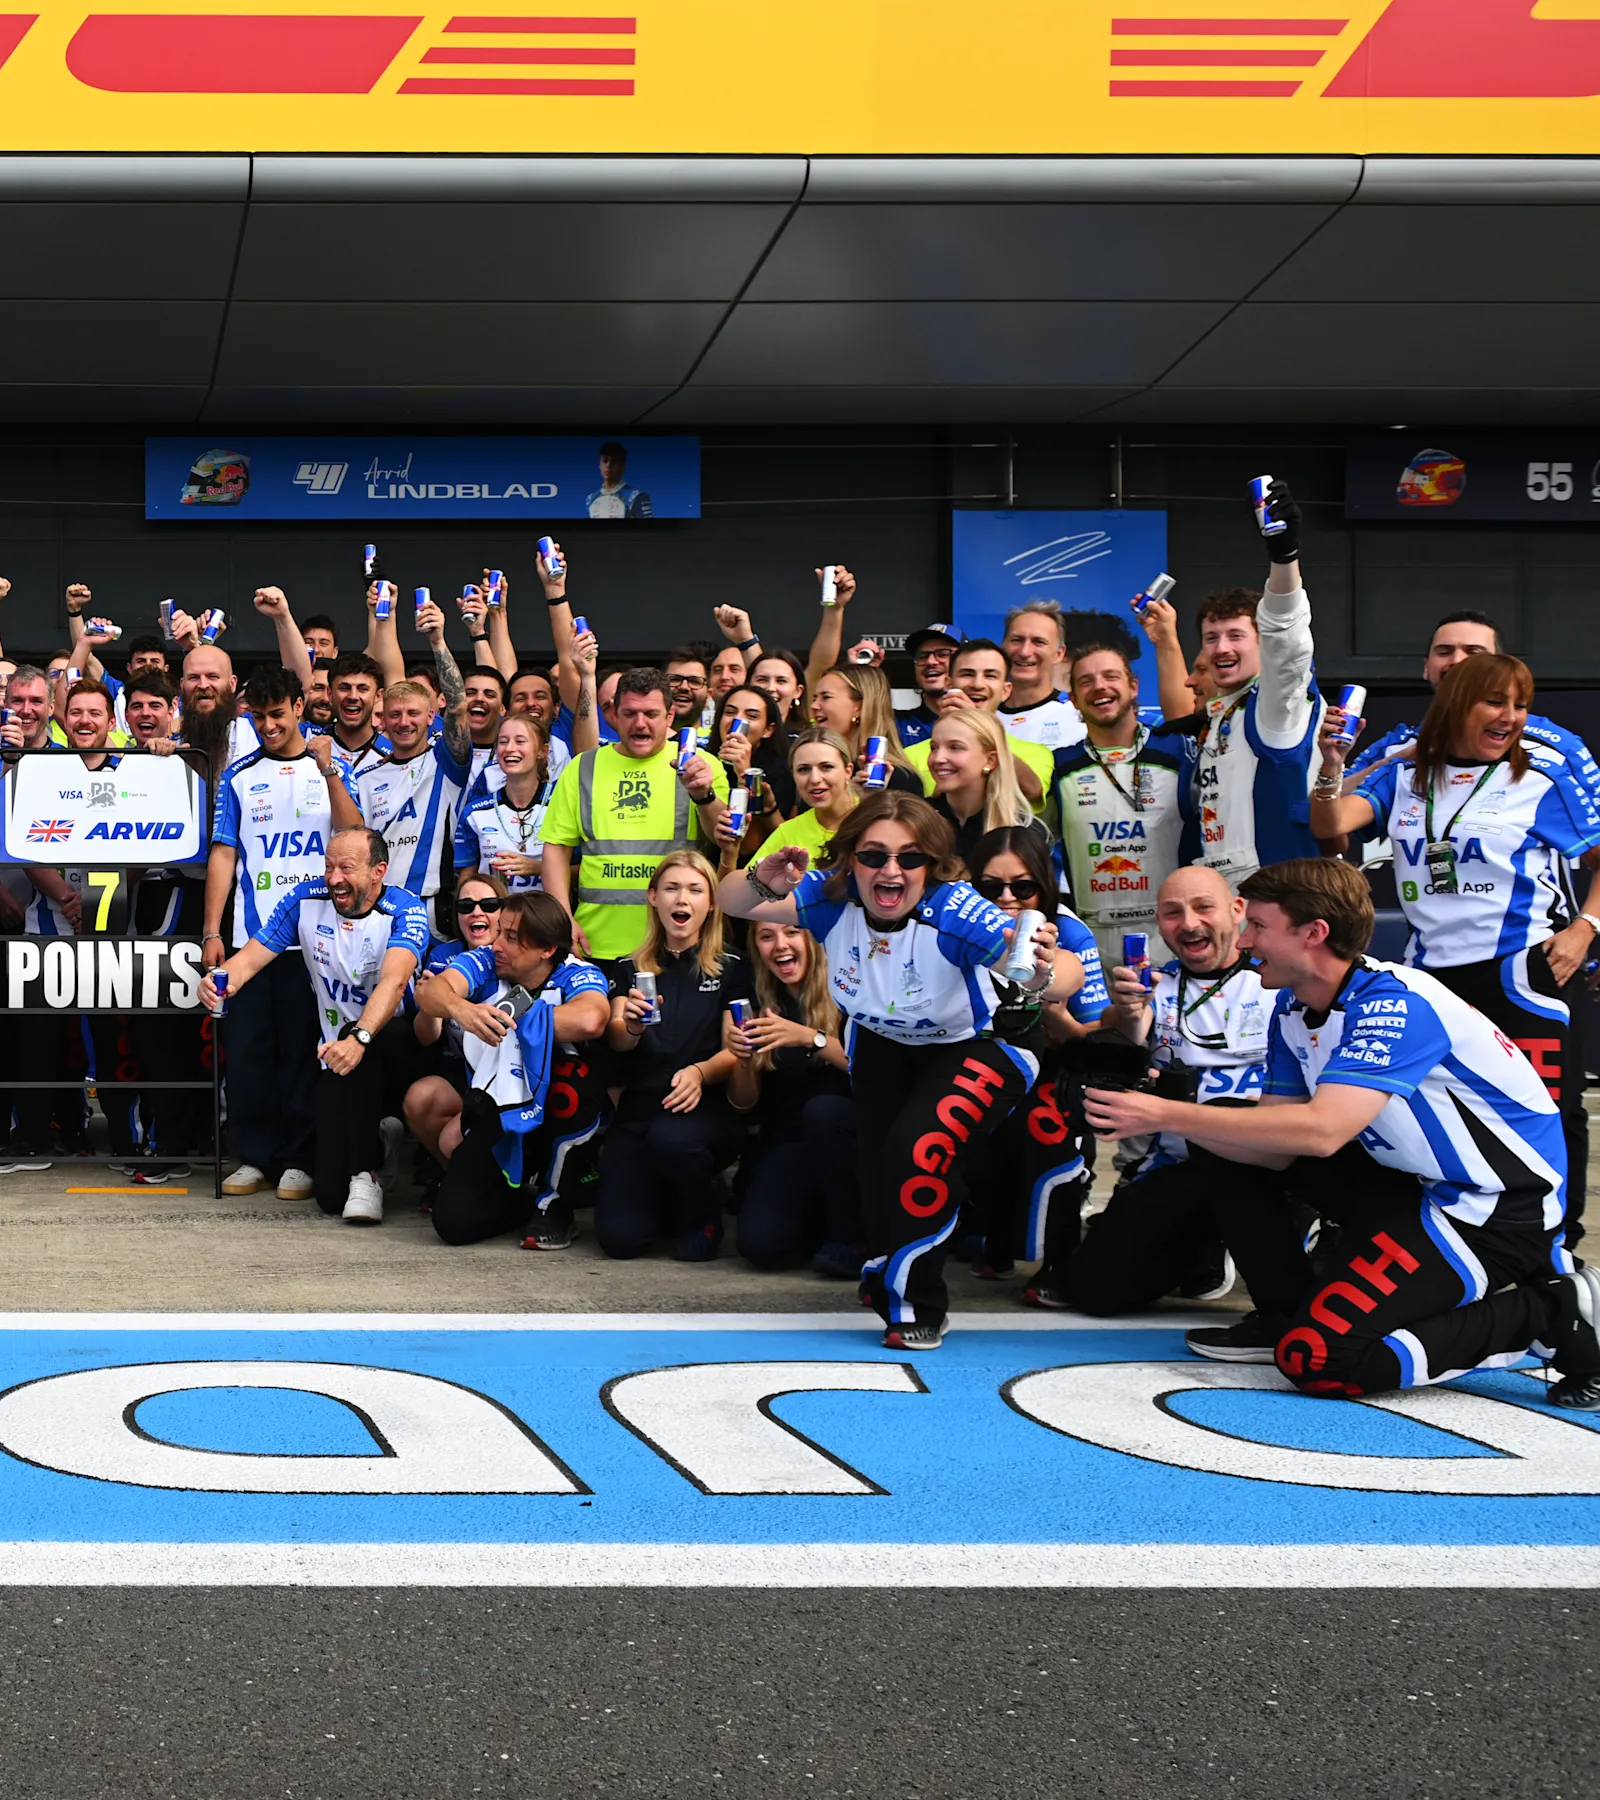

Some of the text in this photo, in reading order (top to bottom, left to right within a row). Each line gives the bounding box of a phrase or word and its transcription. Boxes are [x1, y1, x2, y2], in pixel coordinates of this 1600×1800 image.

[363, 452, 414, 485] Arvid
[293, 461, 349, 495] 41
[1526, 462, 1574, 502] 55
[206, 479, 245, 496] Red Bull
[368, 483, 558, 499] LINDBLAD
[1523, 725, 1562, 743] HUGO
[232, 755, 255, 772] HUGO
[622, 771, 647, 779] VISA
[58, 790, 84, 800] VISA
[1078, 799, 1097, 807] Mobil
[251, 805, 272, 813] TUDOR
[472, 798, 494, 809] HUGO
[252, 813, 273, 823] Mobil
[372, 809, 390, 820] Mobil
[84, 822, 185, 840] ARVID
[1089, 820, 1146, 840] VISA
[254, 830, 325, 859] VISA
[398, 835, 418, 846] App
[1104, 844, 1147, 854] Cash App
[276, 873, 300, 885] Cash
[602, 863, 656, 879] Airtaske
[309, 887, 329, 895] HUG
[1090, 876, 1149, 892] Red Bull
[1463, 882, 1495, 893] App
[87, 871, 120, 931] 7
[944, 886, 972, 912] VISA
[402, 906, 427, 916] VISA
[7, 940, 203, 1009] POINTS
[318, 973, 379, 1006] VIS
[833, 976, 858, 997] Mobil
[1080, 995, 1096, 1004] Red
[1241, 1001, 1260, 1009] VISA
[1358, 999, 1409, 1015] VISA
[1357, 1016, 1407, 1028] PIRELLI
[1155, 1034, 1183, 1048] Mobil
[1339, 1047, 1391, 1067] Red Bull
[900, 1057, 1005, 1218] HUGO
